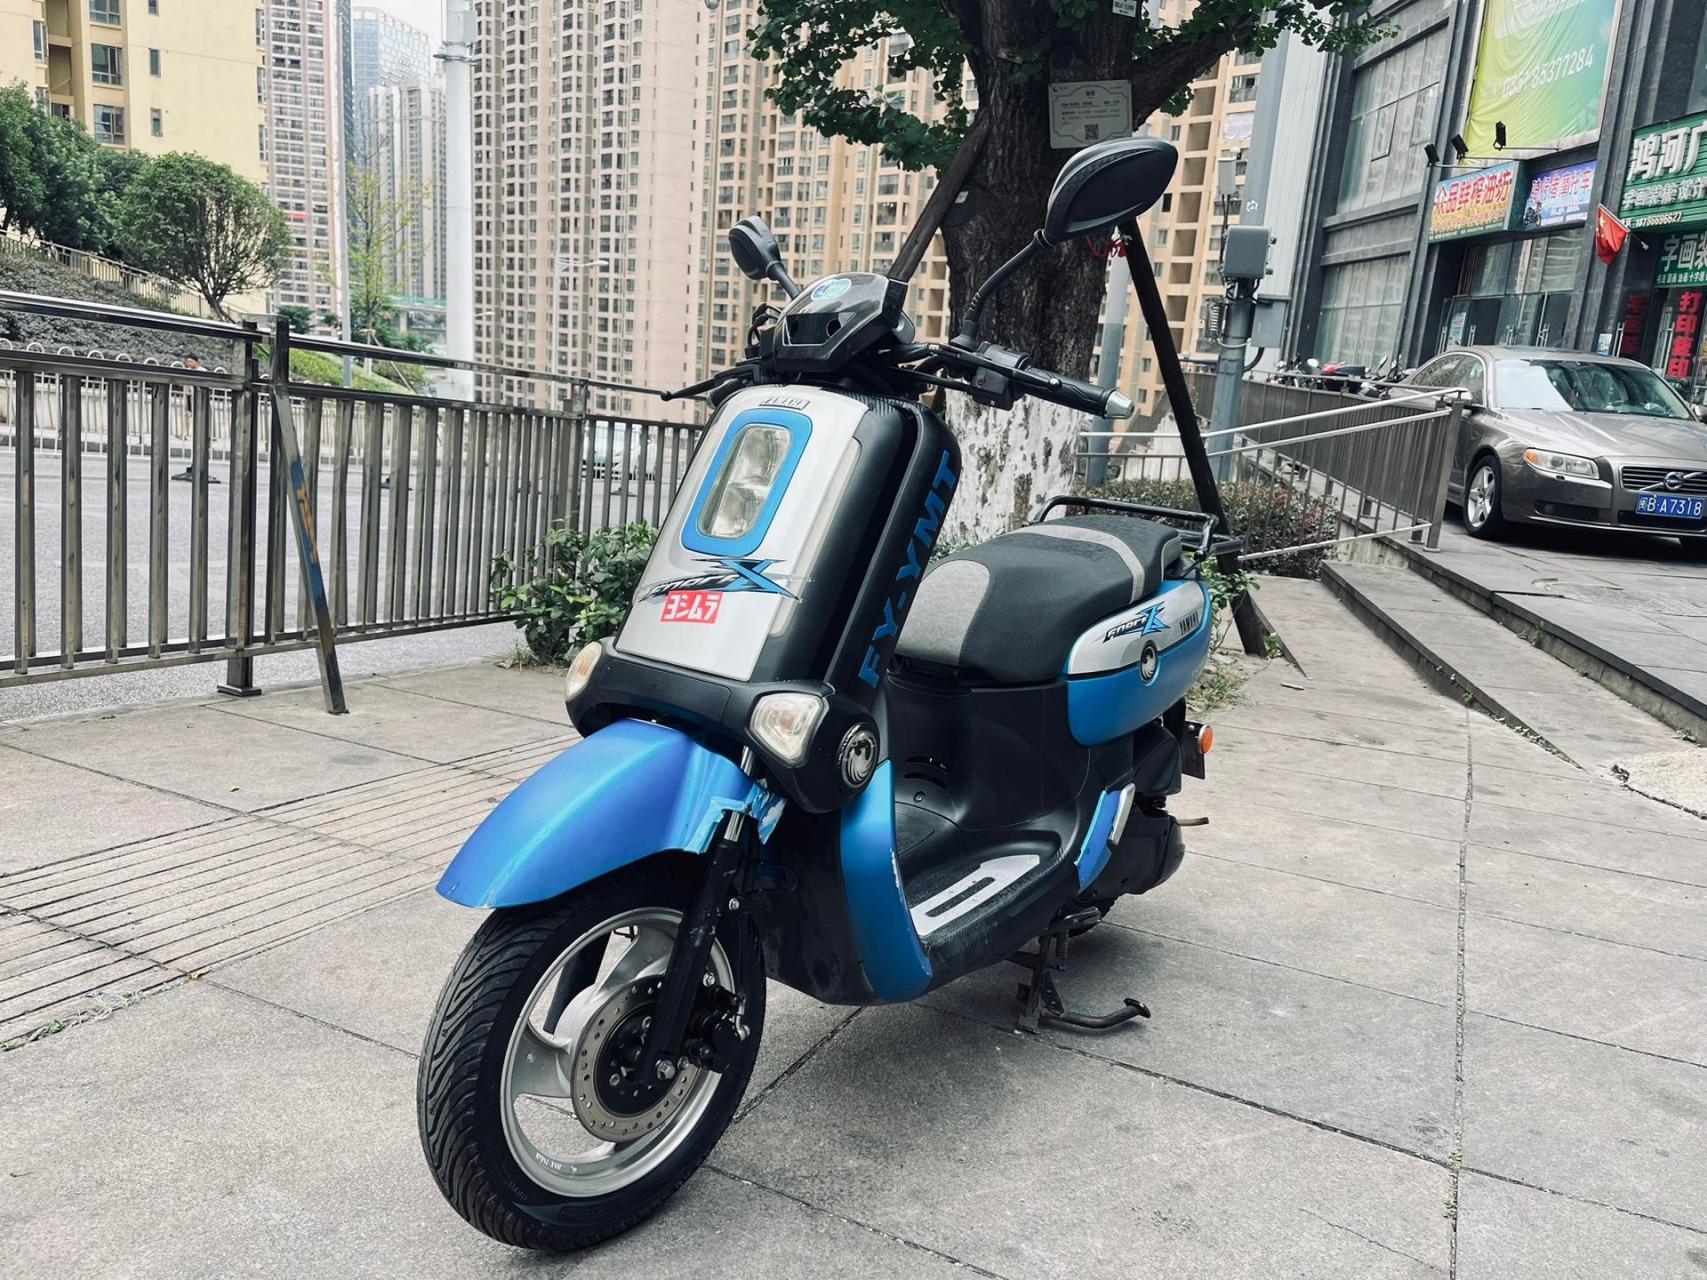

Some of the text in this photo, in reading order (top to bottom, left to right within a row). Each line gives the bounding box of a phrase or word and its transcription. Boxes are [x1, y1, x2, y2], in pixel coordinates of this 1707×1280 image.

[1433, 169, 1512, 215] 众品鲜榨油坊
[858, 450, 957, 689] FY-YMT
[663, 594, 720, 621] ヨシムラ
